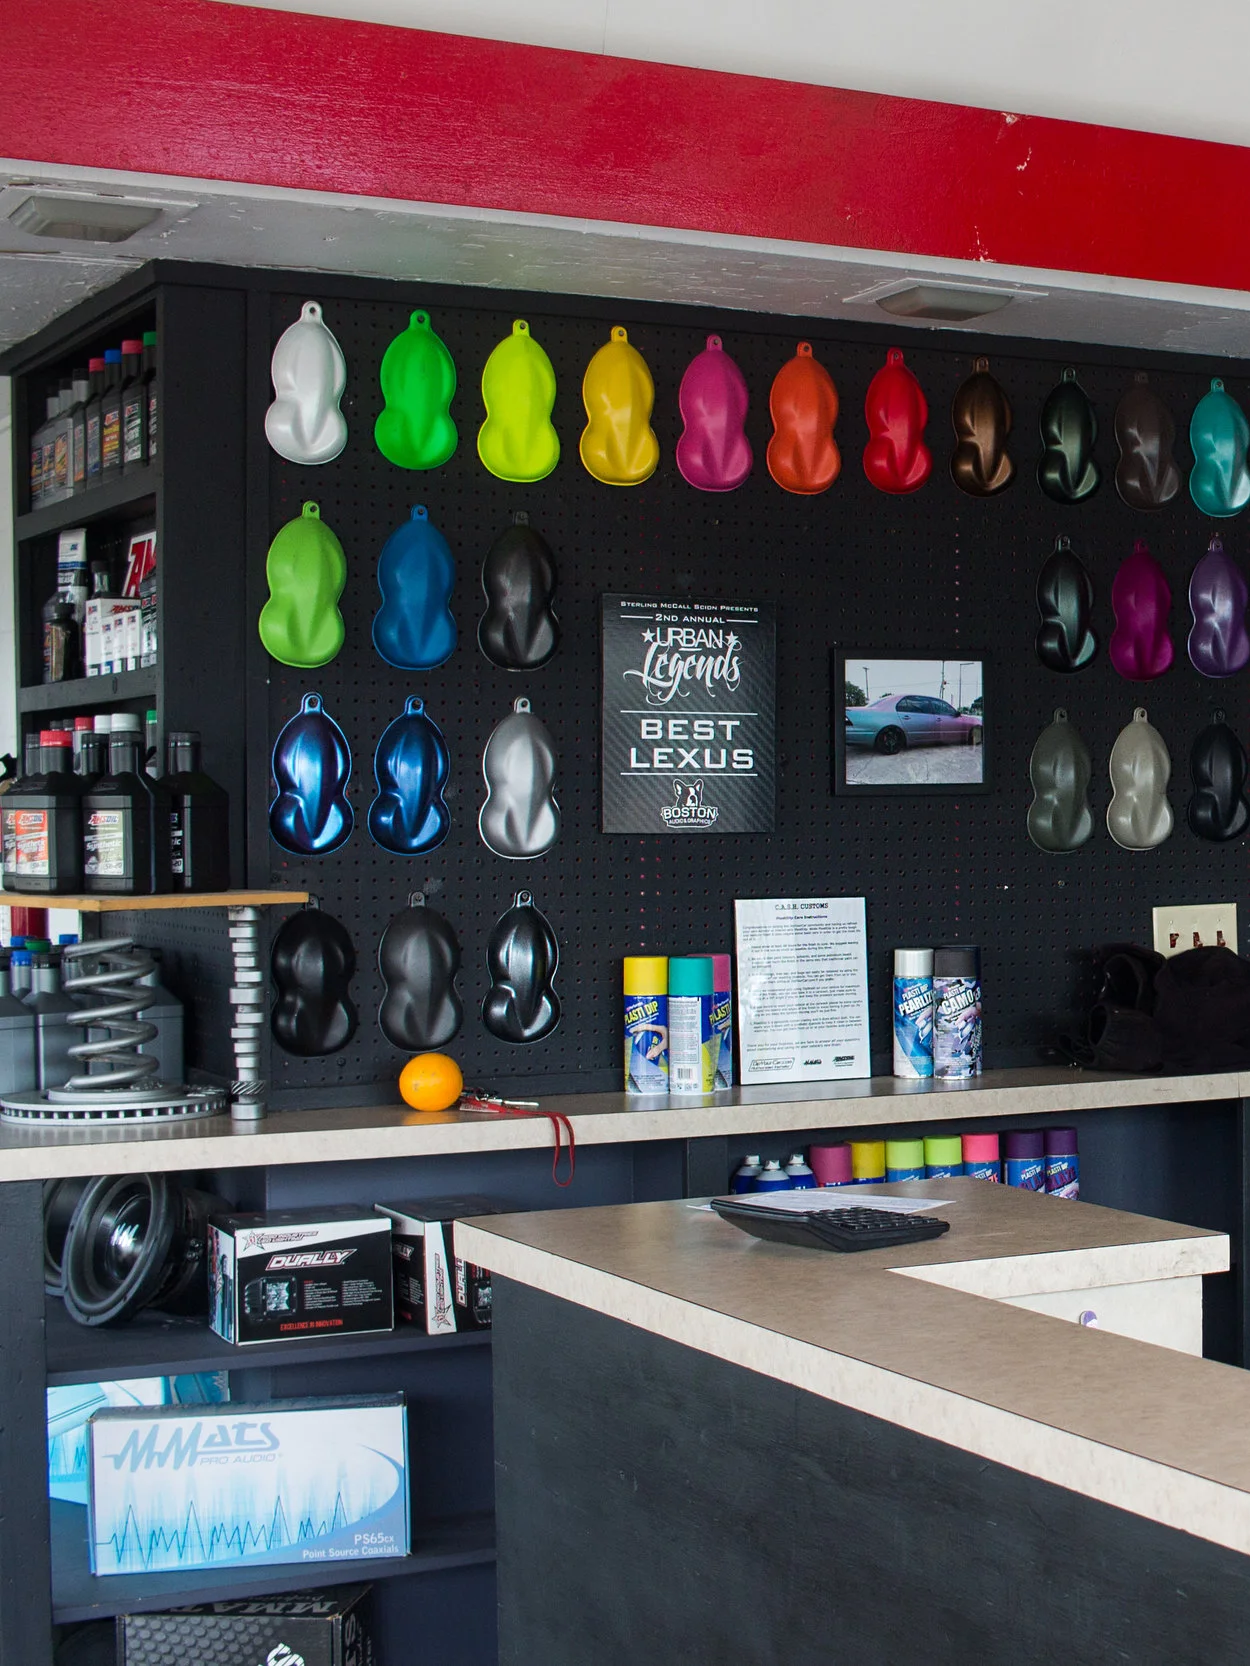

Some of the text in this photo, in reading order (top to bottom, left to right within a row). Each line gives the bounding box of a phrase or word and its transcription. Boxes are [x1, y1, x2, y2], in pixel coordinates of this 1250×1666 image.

[655, 613, 726, 623] 2ND ANNUAL
[656, 627, 723, 648] URBAN
[623, 640, 744, 706] Legends
[641, 719, 740, 741] BEST
[630, 747, 754, 769] LEXUS
[89, 814, 118, 824] AMSOIL
[663, 806, 716, 819] BOSTON
[800, 902, 829, 910] CUSTOMS
[643, 1001, 658, 1016] DIP
[941, 989, 974, 1015] CAMO
[265, 1249, 357, 1271] DUALLY
[200, 1453, 276, 1465] PRO AUDIO
[303, 1545, 399, 1559] Point Source Coaxials
